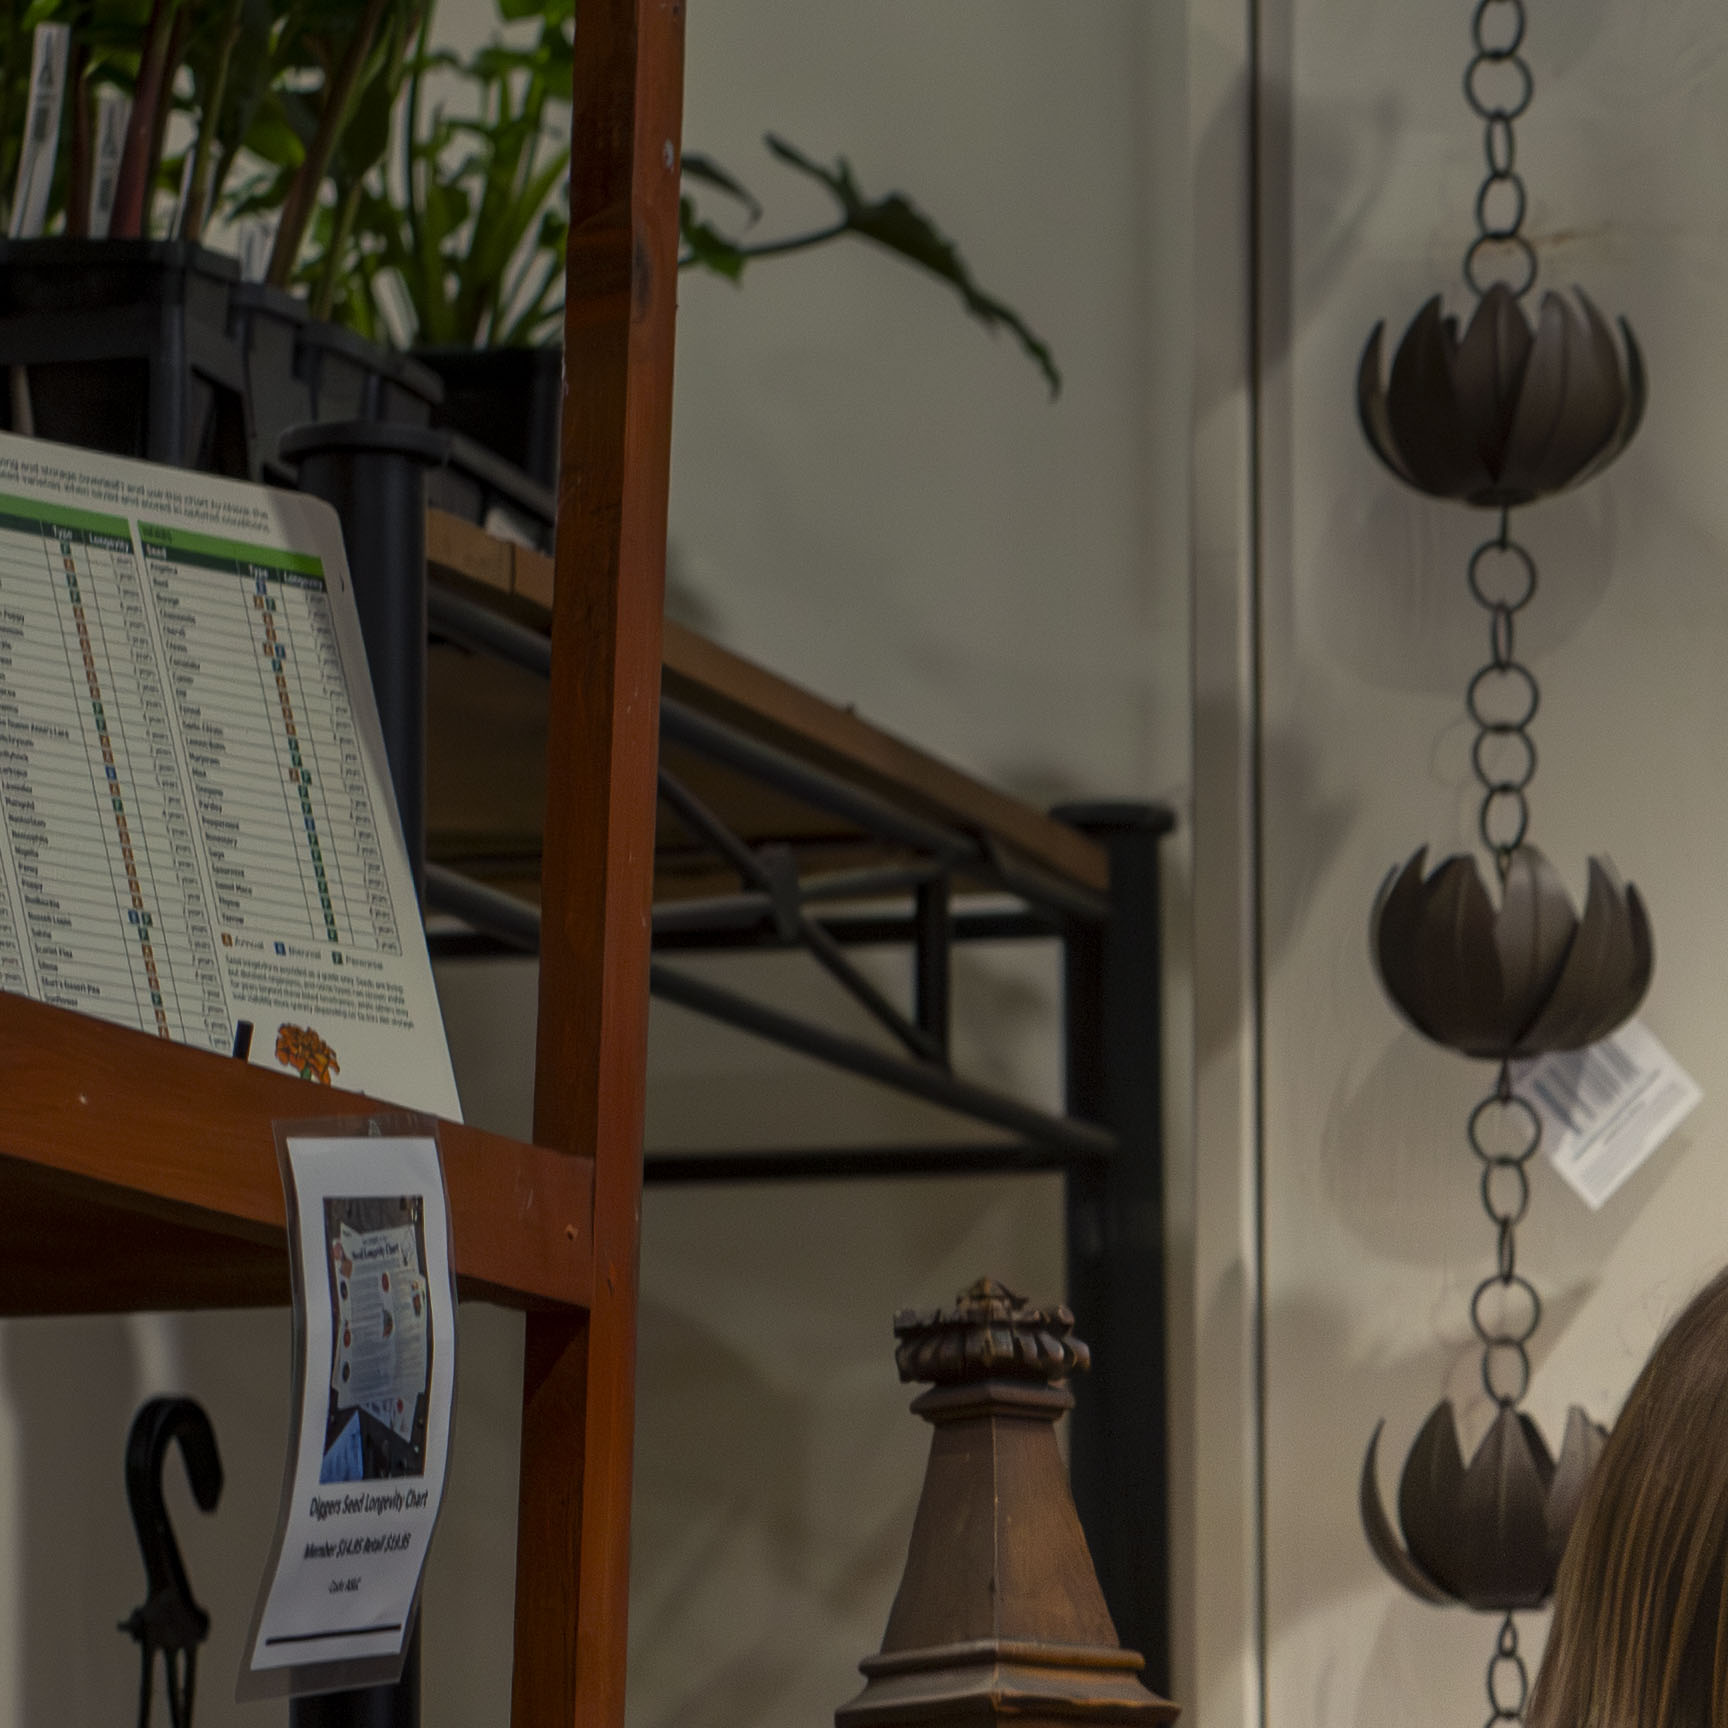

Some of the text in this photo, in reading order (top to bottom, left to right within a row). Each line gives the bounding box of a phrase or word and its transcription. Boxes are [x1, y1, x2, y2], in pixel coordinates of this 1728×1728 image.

[342, 1493, 364, 1514] Seed
[364, 1489, 404, 1515] Longevity
[406, 1488, 428, 1509] Chart
